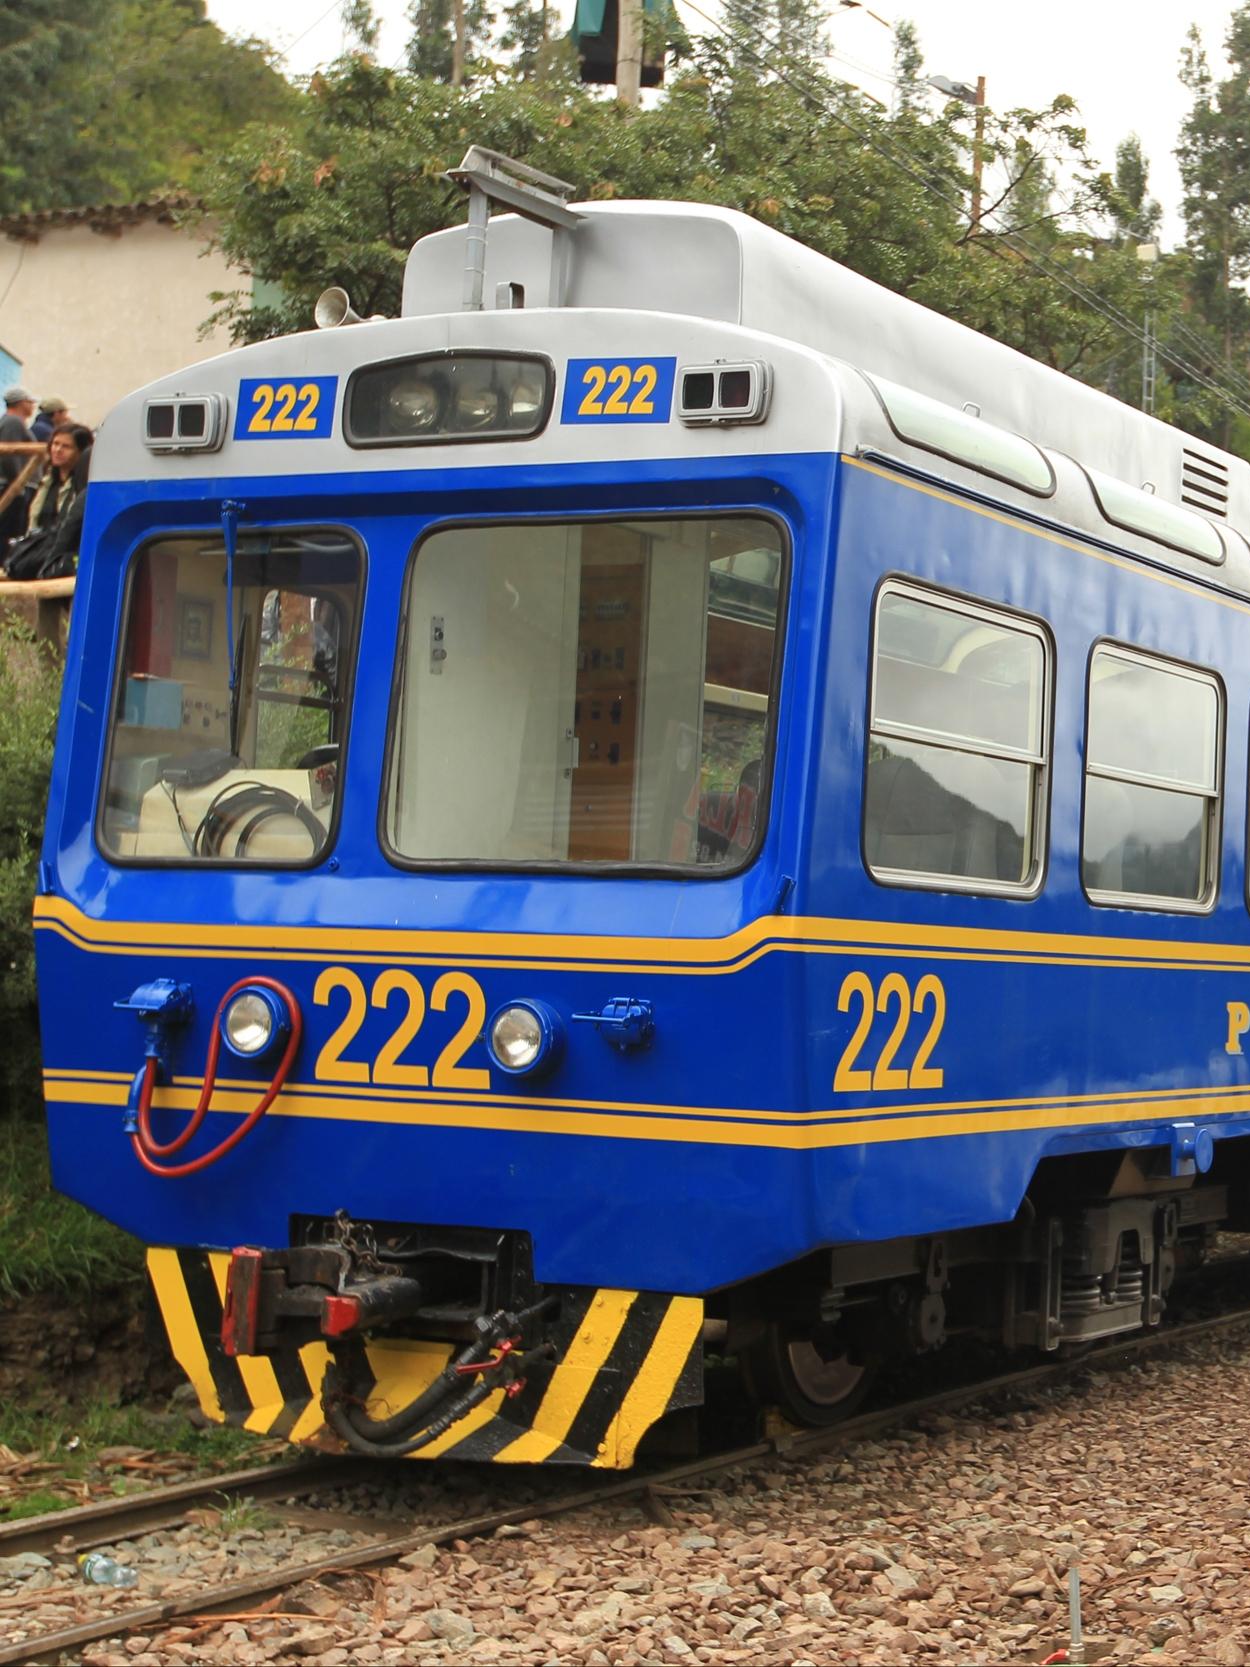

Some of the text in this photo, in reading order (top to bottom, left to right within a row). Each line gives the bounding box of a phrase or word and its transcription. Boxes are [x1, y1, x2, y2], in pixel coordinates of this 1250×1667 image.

[248, 384, 320, 432] 222
[577, 364, 656, 415] 222
[313, 967, 491, 1089] 222
[832, 971, 946, 1092] 222
